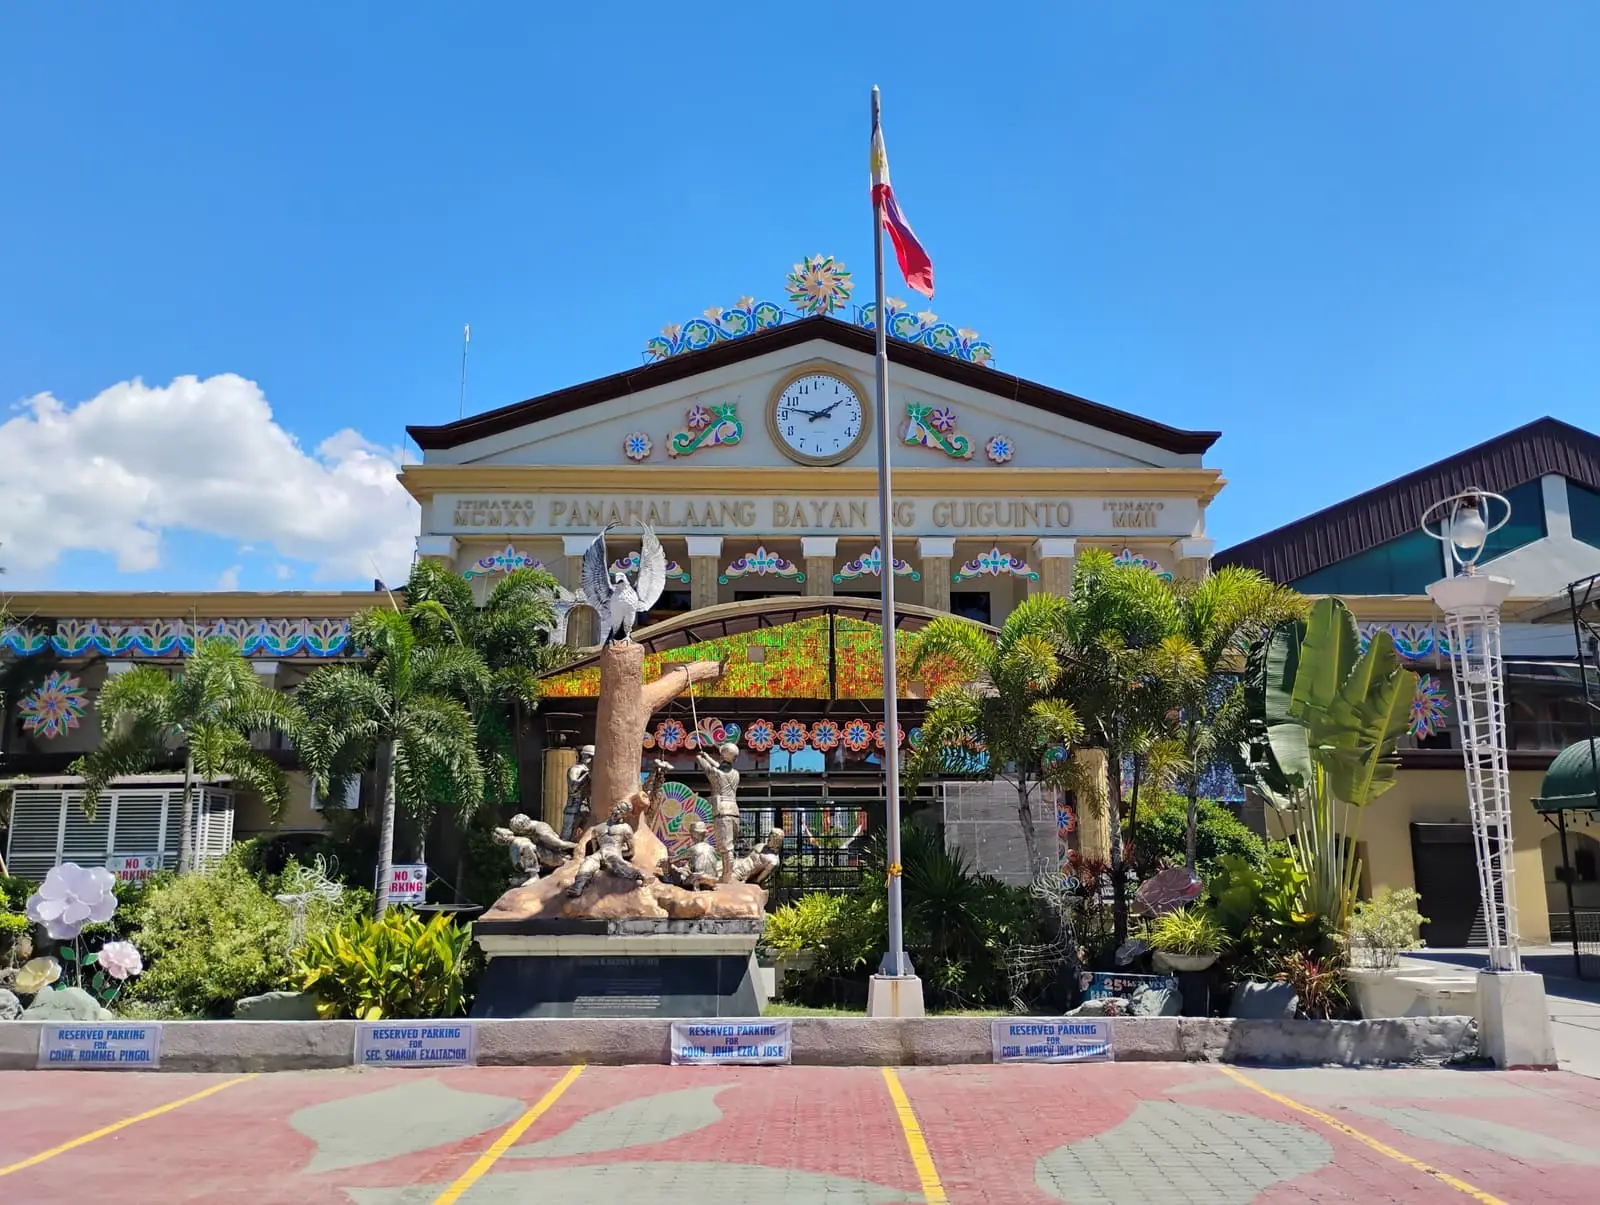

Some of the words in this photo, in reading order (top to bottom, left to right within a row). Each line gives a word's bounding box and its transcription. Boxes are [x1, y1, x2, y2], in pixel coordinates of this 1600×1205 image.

[799, 385, 809, 394] 11
[787, 397, 799, 407] 10
[845, 396, 852, 406] 2
[782, 410, 789, 421] 9
[851, 411, 857, 422] 3
[787, 425, 794, 436] 8
[844, 426, 851, 437] 4
[800, 438, 806, 448] 7
[816, 443, 823, 453] 6
[833, 438, 840, 448] 5
[453, 510, 536, 527] MCMXV
[549, 500, 756, 527] PAMAHALAANG
[772, 501, 867, 527] BAYAN
[932, 501, 1074, 528] GUIGUINTO
[1112, 511, 1157, 528] MMII
[125, 858, 140, 868] NO
[394, 871, 409, 881] NO
[389, 881, 424, 893] RKING
[58, 1029, 104, 1040] RESERVED
[106, 1029, 146, 1040] PARKING
[373, 1029, 419, 1040] RESERVED
[421, 1028, 461, 1039] PARKING
[689, 1026, 733, 1036] RESERVED
[737, 1026, 776, 1036] PARKING
[1009, 1026, 1055, 1036] RESERVED
[1058, 1024, 1097, 1035] PARKING
[93, 1041, 108, 1050] FOR
[409, 1040, 423, 1049] FOR
[725, 1037, 739, 1045] FOR
[1046, 1036, 1061, 1045] FOR
[49, 1050, 76, 1061] COUN.
[79, 1050, 117, 1061] ROMMEL
[119, 1050, 150, 1061] PINGOL
[365, 1049, 383, 1061] SEC.
[385, 1049, 418, 1060] SHARON
[420, 1048, 467, 1060] EXALTACION
[681, 1046, 709, 1058] COUN.
[712, 1045, 735, 1057] JOHN
[737, 1045, 760, 1057] EZRA
[763, 1045, 784, 1057] JOSE
[1025, 1045, 1054, 1057] ANDREW
[1057, 1045, 1074, 1056] JOHN
